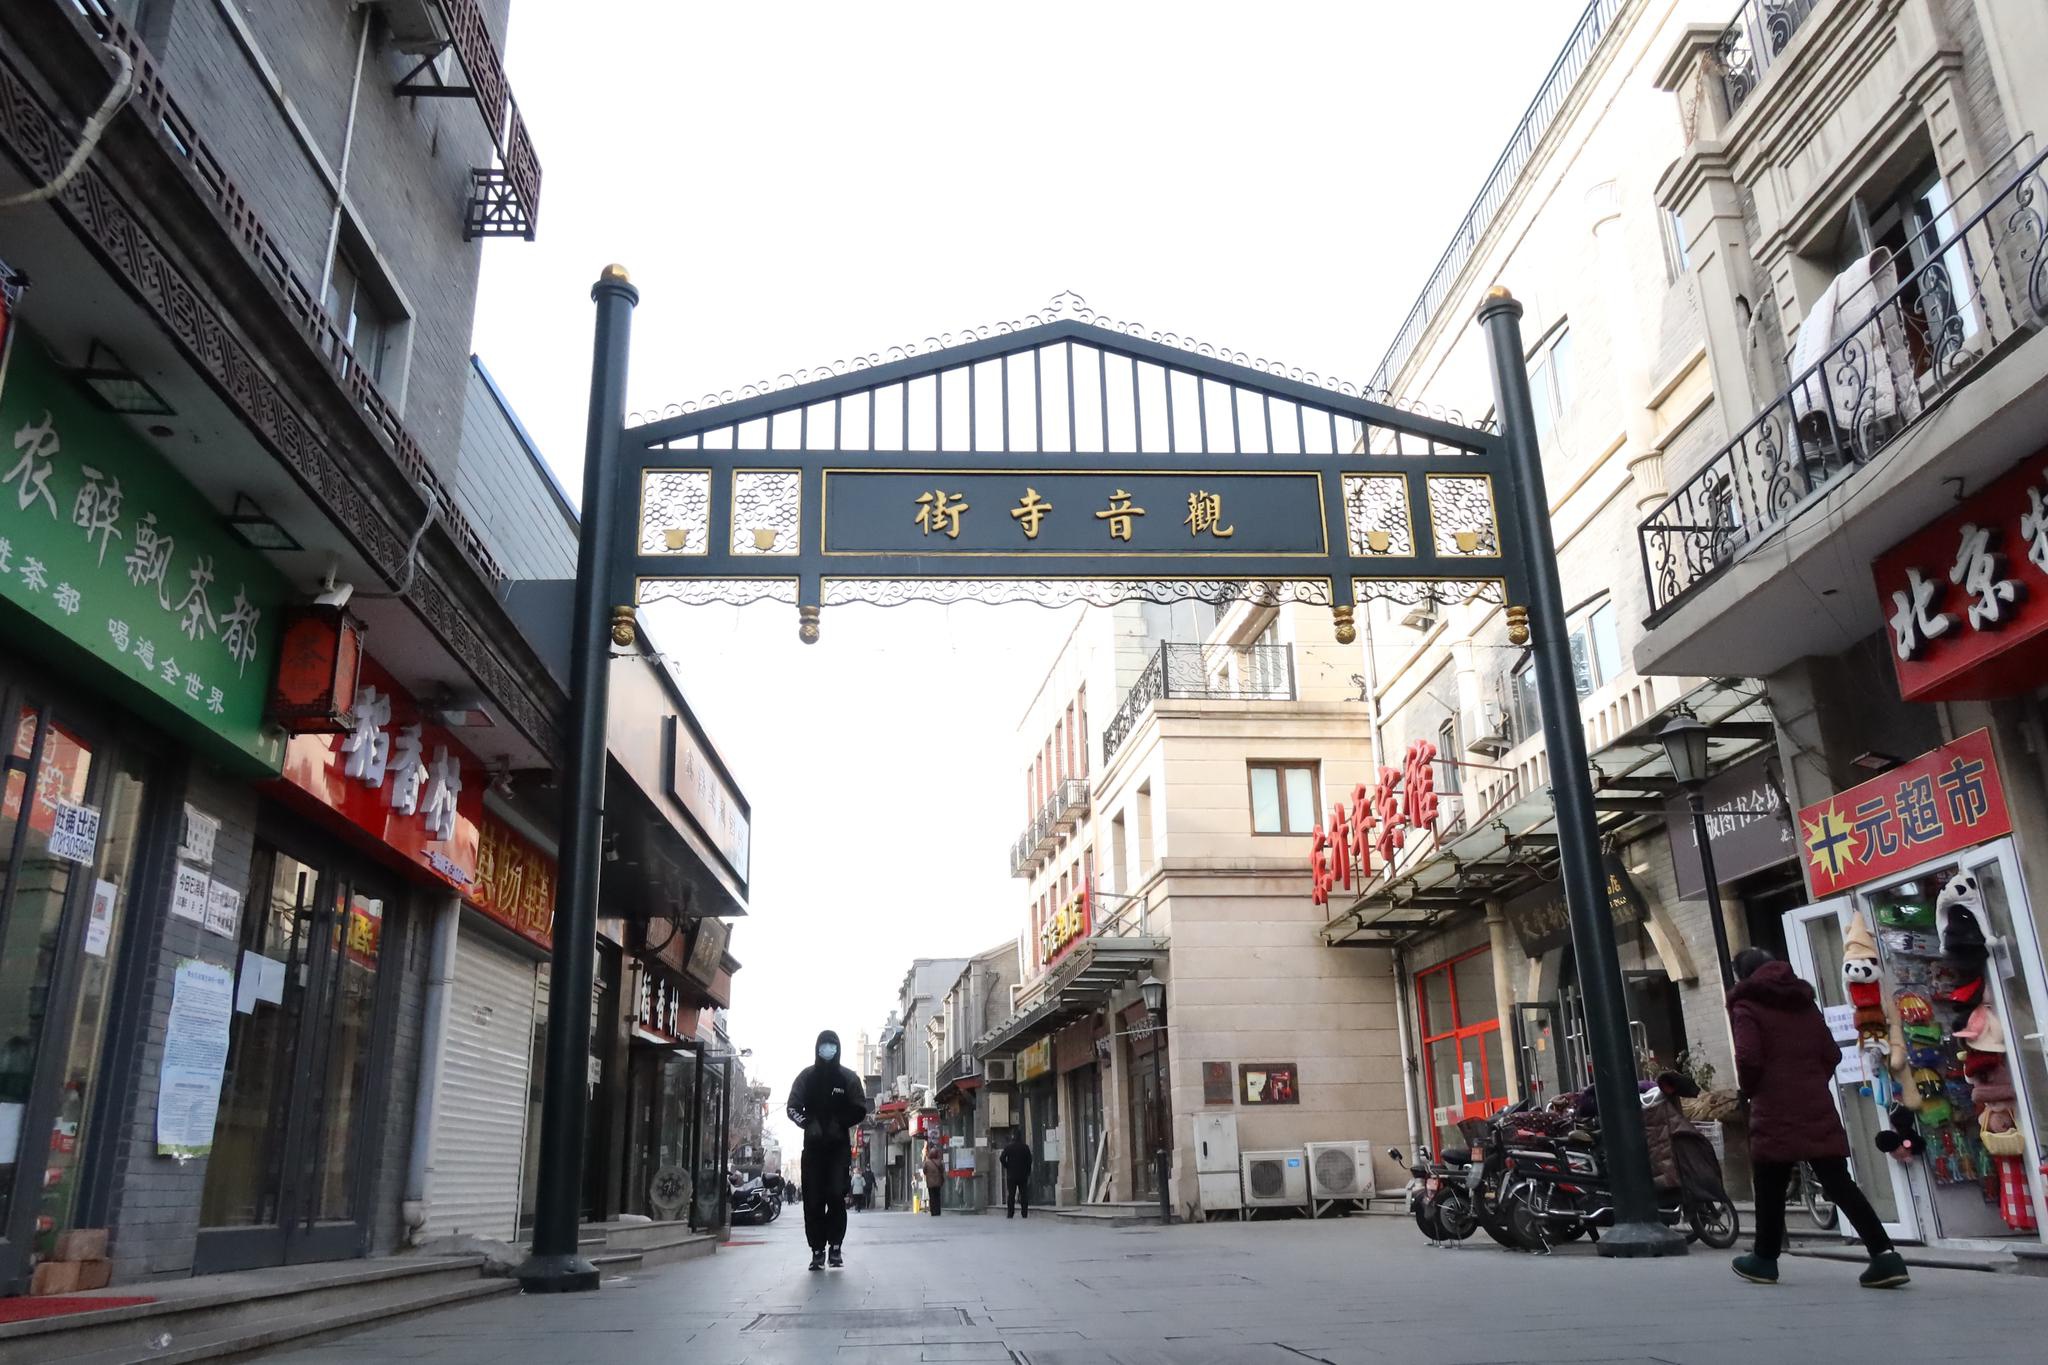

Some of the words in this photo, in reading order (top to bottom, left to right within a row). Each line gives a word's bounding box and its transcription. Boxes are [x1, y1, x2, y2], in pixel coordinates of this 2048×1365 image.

[107, 618, 225, 715] 喝遍全世界
[341, 684, 462, 841] 稻香村
[1811, 756, 1990, 876] 十元超市
[640, 971, 679, 1038] 稻香村
